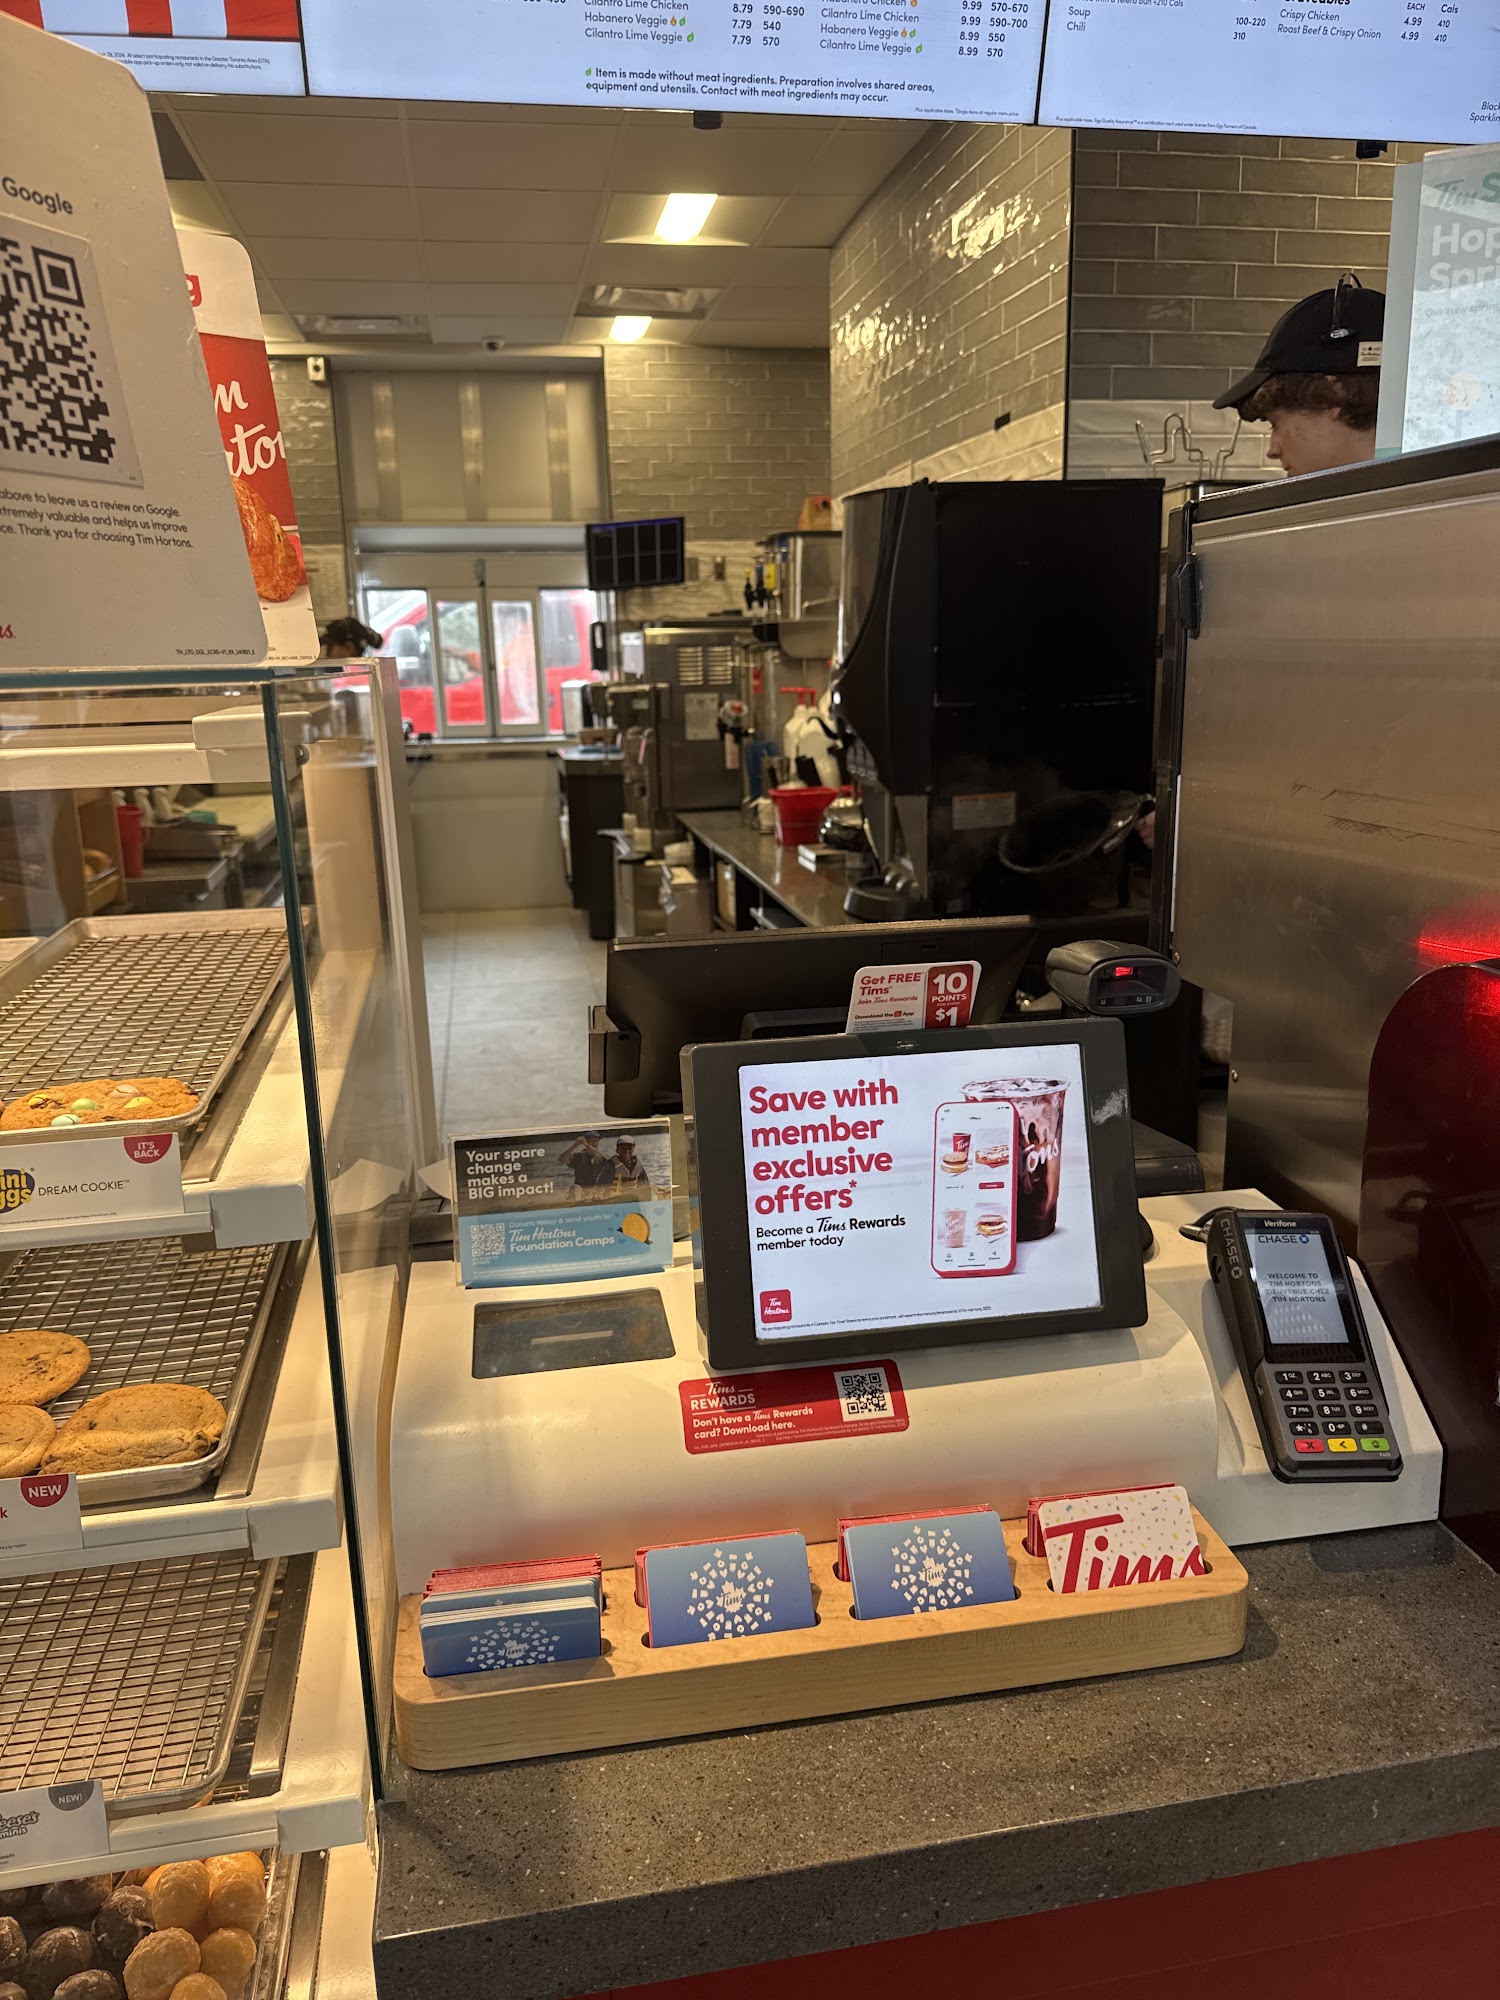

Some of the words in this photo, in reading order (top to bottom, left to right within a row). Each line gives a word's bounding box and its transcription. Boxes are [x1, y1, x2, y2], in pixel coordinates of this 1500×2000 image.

[732, 3, 753, 14] 8.79
[763, 5, 805, 16] 590-690
[962, 0, 982, 10] 9.99
[991, 2, 1029, 13] 570-670
[1068, 6, 1091, 19] Soup
[1406, 2, 1426, 11] EACH
[1441, 4, 1459, 14] Cals
[584, 12, 634, 24] Habanero
[635, 14, 668, 28] Veggie
[821, 8, 858, 20] Cilantro
[860, 10, 882, 21] Lime
[884, 11, 920, 22] Chicken
[960, 16, 981, 26] 9.99
[989, 18, 1028, 28] 590-700
[1236, 16, 1266, 27] 100-220
[1280, 8, 1306, 22] Crispy
[1308, 10, 1340, 22] Chicken
[732, 19, 752, 30] 7.79
[762, 20, 781, 31] 540
[1066, 22, 1086, 32] Chili
[1403, 17, 1422, 26] 4.99
[1437, 19, 1450, 28] 410
[584, 28, 624, 40] Cilantro
[626, 30, 648, 40] Lime
[650, 31, 682, 44] Veggie
[820, 24, 867, 36] Habanero
[868, 26, 899, 40] Veggie
[960, 31, 980, 41] 8.99
[988, 32, 1006, 42] 550
[1233, 32, 1246, 40] 310
[1277, 24, 1300, 34] Roast
[1302, 26, 1320, 35] Beef
[1330, 28, 1356, 40] Crispy
[1356, 29, 1382, 39] Onion
[1400, 32, 1420, 41] 4.99
[1434, 34, 1448, 42] 410
[731, 34, 752, 45] 7.79
[762, 36, 780, 46] 570
[820, 39, 856, 50] Cilantro
[858, 41, 880, 52] Lime
[881, 42, 912, 56] Veggie
[958, 46, 978, 56] 8.99
[986, 48, 1004, 58] 570
[595, 68, 617, 78] Item
[618, 69, 627, 78] is
[628, 70, 656, 80] made
[658, 71, 694, 82] without
[696, 73, 721, 82] meat
[722, 73, 778, 86] ingredients.
[779, 75, 834, 88] Preparation
[836, 78, 872, 90] involves
[874, 80, 906, 90] shared
[907, 82, 935, 93] areas,
[586, 80, 638, 93] equipment
[640, 82, 658, 92] and
[660, 84, 699, 94] utensils.
[700, 84, 738, 96] Contact
[740, 86, 759, 97] with
[761, 89, 786, 98] meat
[787, 88, 838, 101] ingredients
[840, 92, 860, 104] may
[862, 93, 888, 102] occur.
[2, 176, 74, 215] Google
[34, 492, 46, 504] to
[48, 493, 76, 507] leave
[78, 498, 90, 508] us
[91, 500, 98, 508] a
[100, 500, 130, 512] review
[132, 504, 145, 514] on
[146, 504, 181, 518] Google.
[47, 511, 90, 524] valuable
[92, 516, 112, 526] and
[114, 516, 138, 530] helps
[140, 520, 150, 530] us
[151, 520, 188, 534] improve
[17, 523, 52, 537] Thank
[53, 528, 72, 540] you
[74, 528, 88, 540] for
[92, 531, 135, 546] choosing
[136, 533, 154, 545] Tim
[155, 535, 194, 548] Hortons.
[860, 975, 885, 986] Get
[932, 972, 968, 994] 10
[932, 993, 967, 1003] POINTS
[854, 1012, 884, 1020] Download
[935, 1006, 958, 1026] $1
[749, 1086, 826, 1114] Save
[833, 1078, 898, 1108] with
[752, 1114, 885, 1148] member
[137, 1141, 155, 1151] IT'S
[134, 1149, 160, 1159] BACK
[466, 1151, 500, 1163] Your
[504, 1148, 546, 1161] spare
[466, 1161, 522, 1176] change
[752, 1146, 893, 1181] exclusive
[467, 1174, 514, 1188] makes
[518, 1174, 528, 1184] a
[38, 1184, 78, 1197] DREAM
[468, 1187, 494, 1200] BIG
[498, 1181, 554, 1198] impact!
[508, 1220, 536, 1229] Donate
[536, 1218, 557, 1228] today
[564, 1216, 582, 1224] send
[582, 1214, 602, 1224] youth
[603, 1213, 611, 1221] to
[756, 1224, 804, 1238] Become
[806, 1225, 814, 1234] a
[816, 1216, 846, 1233] Tims
[850, 1214, 906, 1230] Rewards
[1264, 1220, 1297, 1228] Verifone
[508, 1228, 530, 1243] Tim
[532, 1226, 576, 1240] Hortons
[1220, 1218, 1238, 1265] CHASE
[1258, 1235, 1298, 1244] CHASE
[510, 1238, 574, 1253] Foundation
[575, 1235, 615, 1247] Camps
[757, 1236, 806, 1251] member
[809, 1234, 844, 1246] today
[768, 1298, 782, 1308] Tim
[764, 1306, 790, 1316] Hortons
[705, 1381, 735, 1396] Tims
[690, 1393, 756, 1411] REWARDS
[692, 1416, 718, 1428] Don't
[720, 1414, 743, 1426] have
[744, 1414, 751, 1422] a
[752, 1410, 771, 1421] Tims
[772, 1406, 814, 1419] Rewards
[694, 1427, 721, 1440] card?
[723, 1424, 770, 1436] Download
[772, 1420, 796, 1432] here.
[28, 1484, 62, 1498] NEW
[58, 1793, 82, 1804] NEW!
